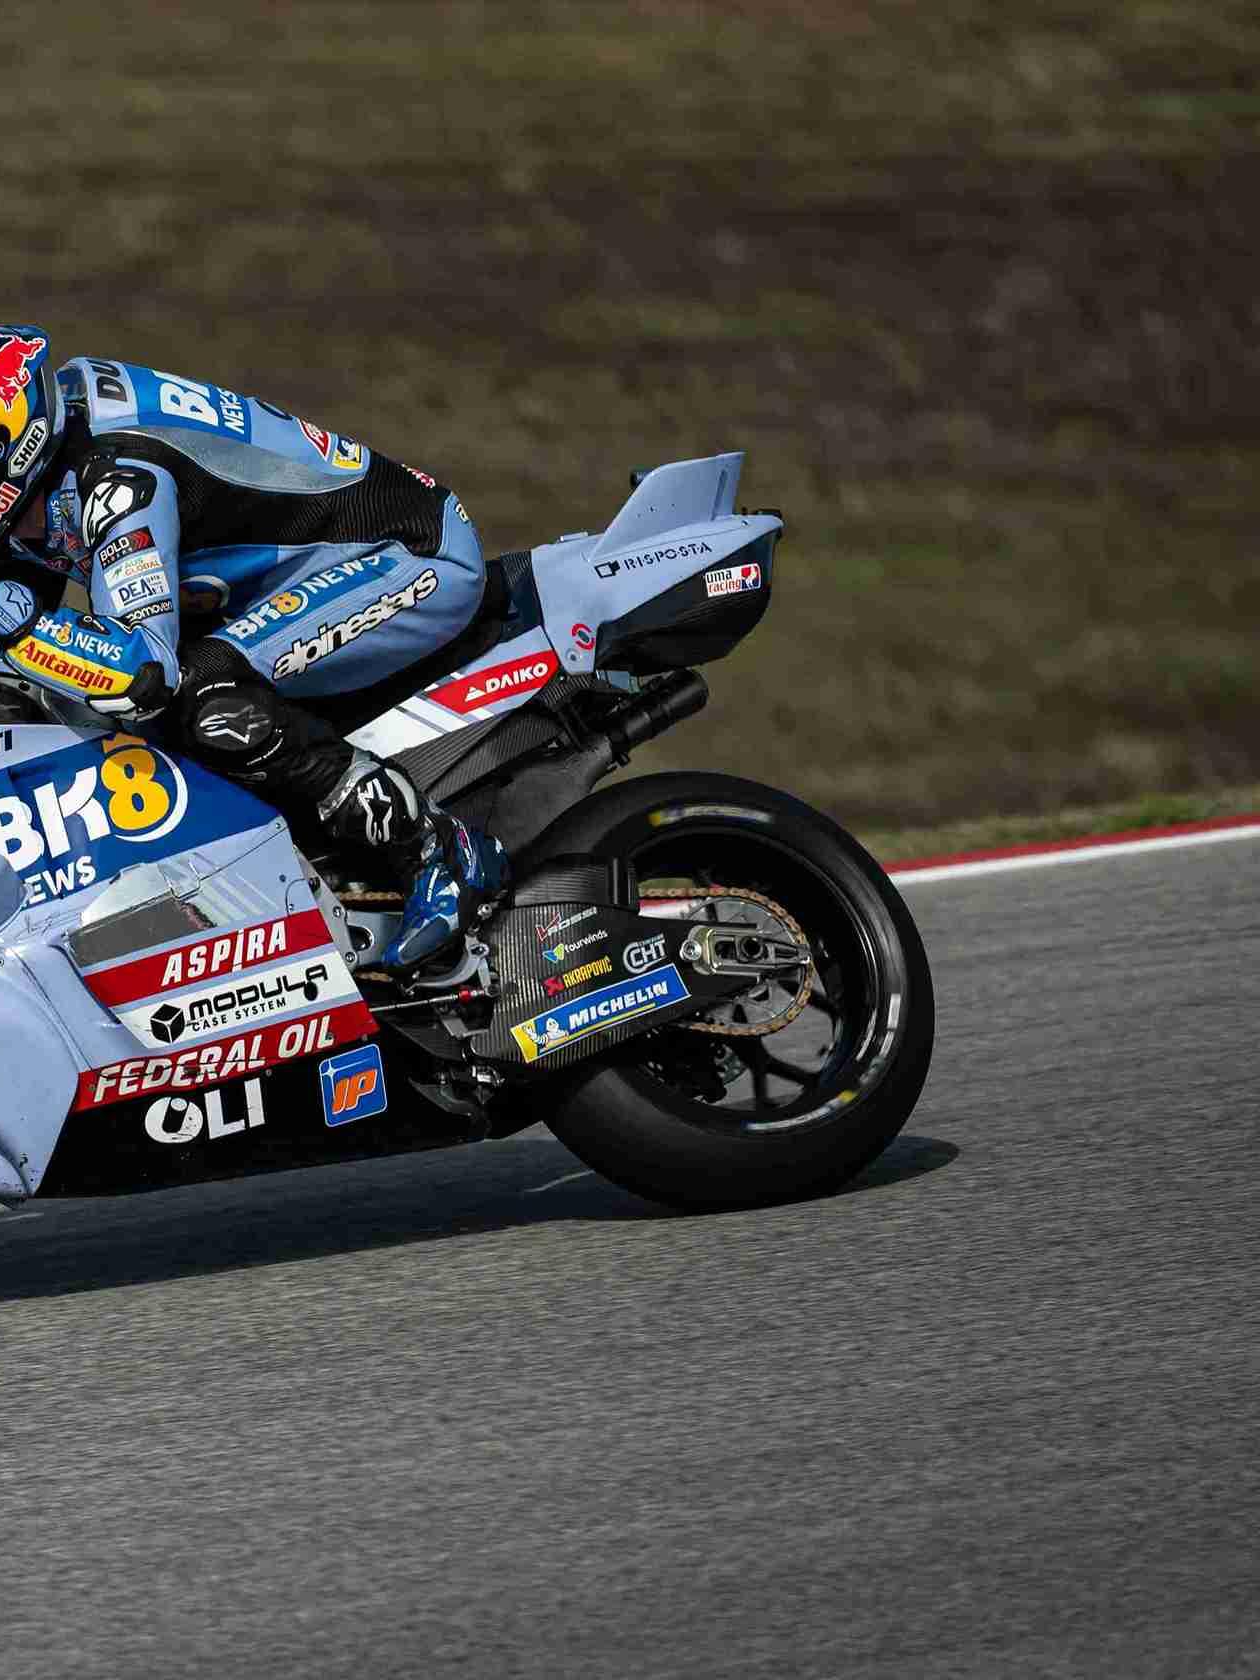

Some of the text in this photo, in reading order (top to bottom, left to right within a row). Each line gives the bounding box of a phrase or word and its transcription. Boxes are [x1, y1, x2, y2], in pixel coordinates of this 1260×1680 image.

[13, 425, 47, 470] SHOEI
[99, 535, 131, 562] BOLD
[624, 543, 713, 571] RISPOSTA
[706, 571, 733, 584] uma
[708, 580, 741, 593] racing
[272, 567, 439, 681] alpinestars
[18, 639, 115, 692] Antangin
[74, 631, 124, 662] NEWS
[485, 662, 549, 694] DAIKO
[23, 855, 97, 905] EWS
[161, 920, 288, 987] ASPIRA
[564, 930, 608, 954] fourwinds
[192, 998, 288, 1033] CASE SYSTEM
[569, 980, 669, 1031] MICHELIN
[93, 1015, 336, 1103] FEDERAL OIL
[145, 1077, 266, 1144] OLI
